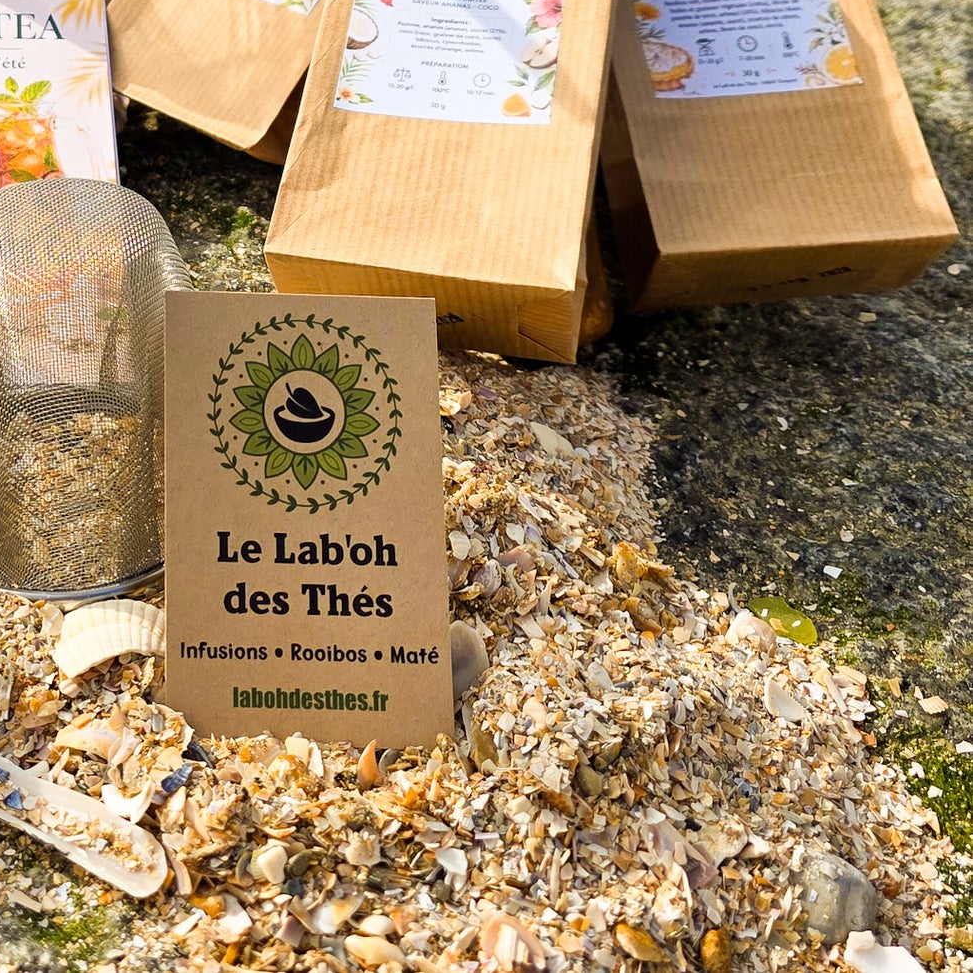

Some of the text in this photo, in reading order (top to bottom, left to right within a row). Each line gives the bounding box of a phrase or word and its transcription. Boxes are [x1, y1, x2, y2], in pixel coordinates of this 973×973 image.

[420, 60, 469, 69] PRÉPARATION
[217, 531, 398, 567] Le Lab'oh
[223, 582, 393, 618] des Thés
[180, 641, 440, 665] Infusions Rooibos Maté
[232, 686, 389, 712] labohdesthes.fr
